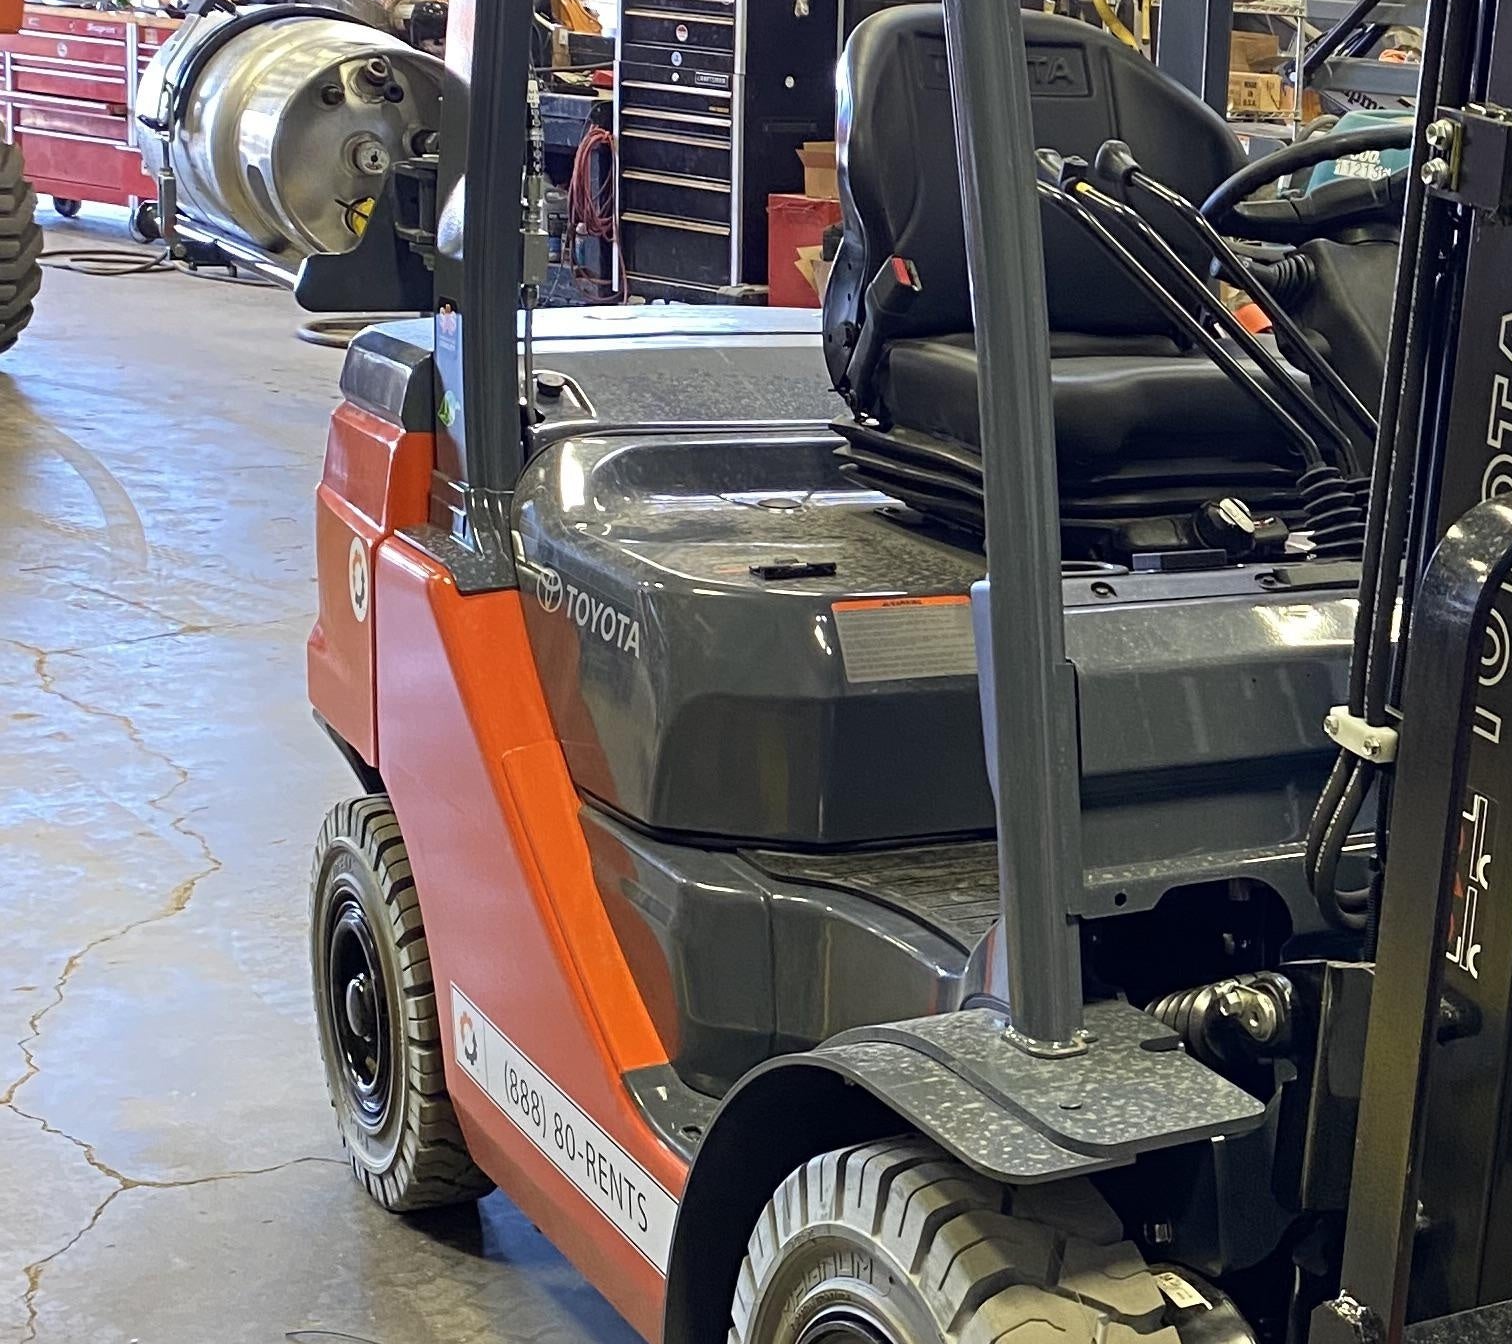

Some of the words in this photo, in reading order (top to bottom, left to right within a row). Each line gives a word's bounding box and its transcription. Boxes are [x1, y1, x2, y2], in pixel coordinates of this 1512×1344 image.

[566, 584, 640, 659] TOYOTA
[504, 1059, 547, 1139] (888)
[554, 1111, 649, 1234] 80-RENTS
